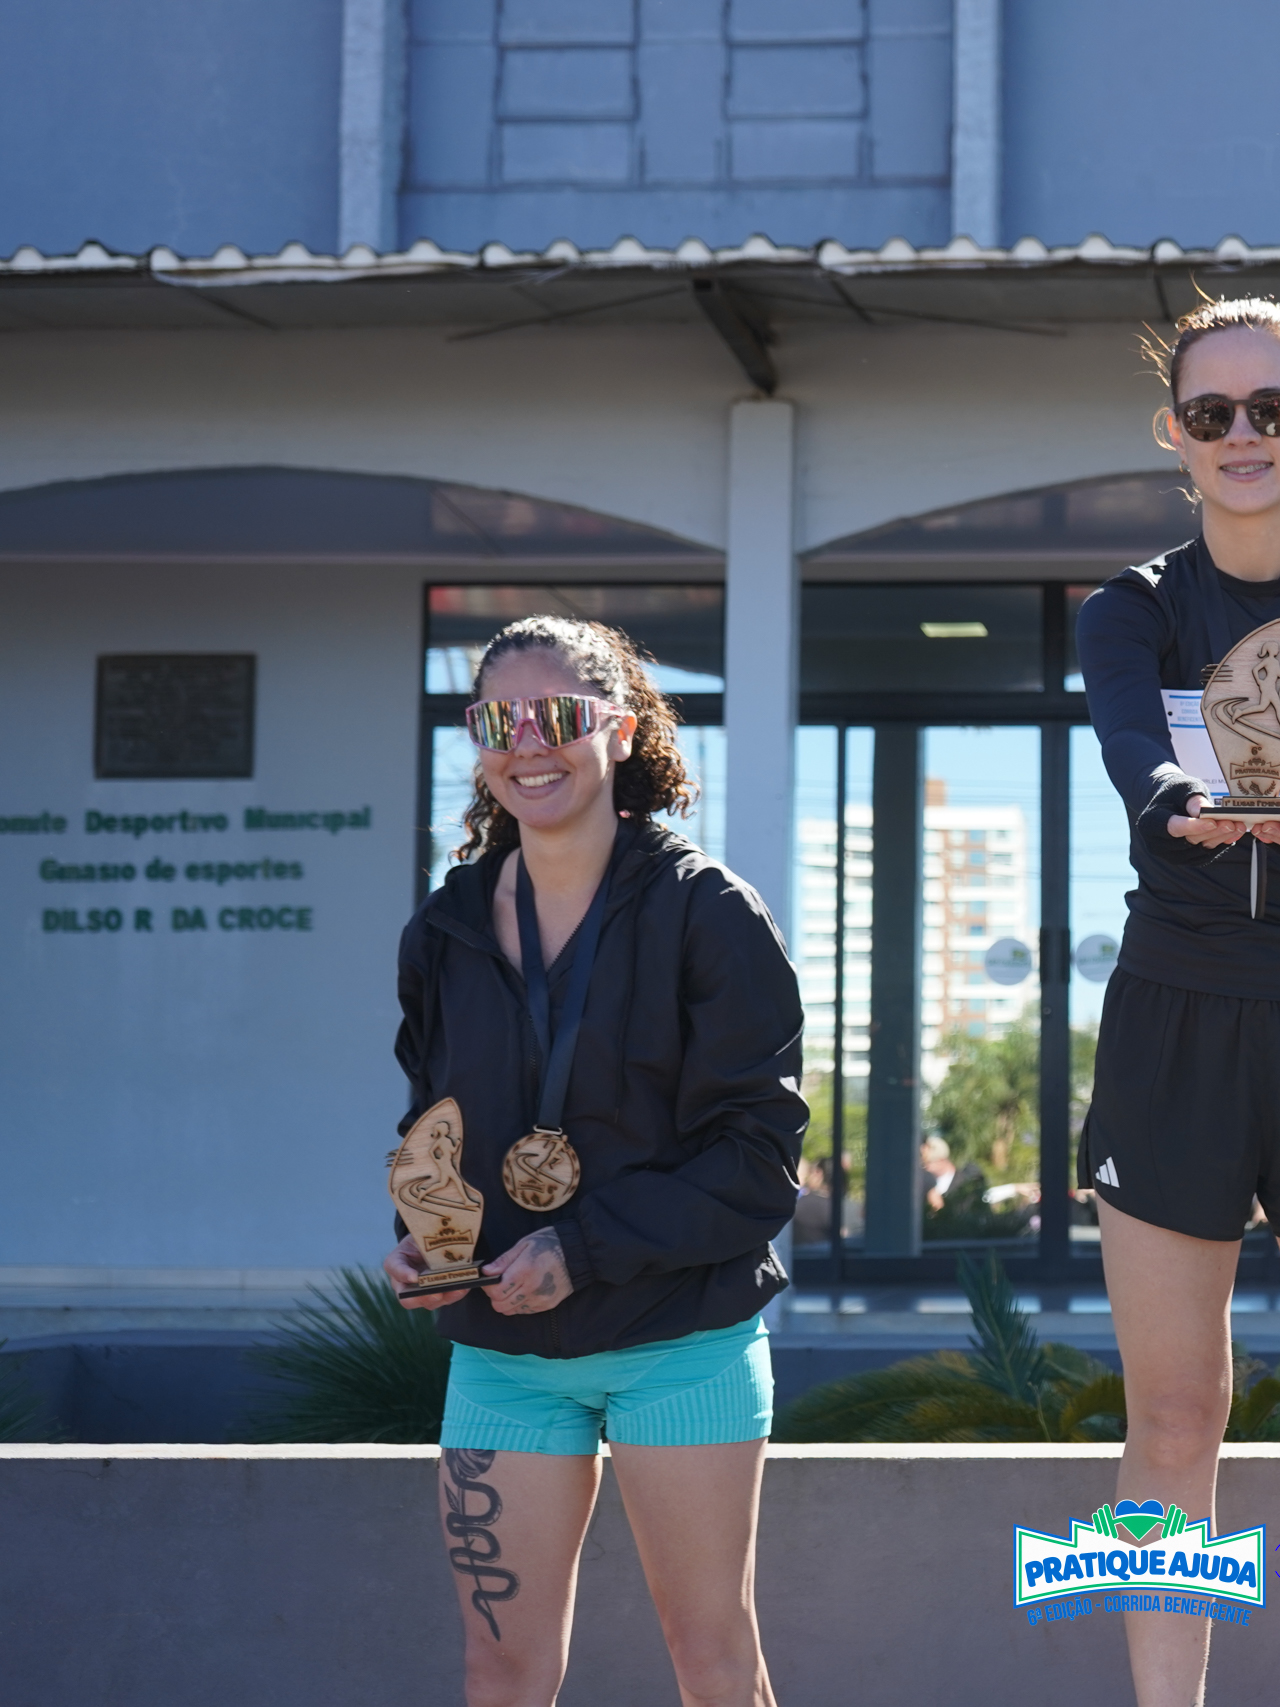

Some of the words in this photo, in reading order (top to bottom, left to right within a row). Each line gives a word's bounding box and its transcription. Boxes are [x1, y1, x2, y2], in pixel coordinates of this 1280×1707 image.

[244, 805, 371, 835] Municipal
[146, 857, 175, 882] de
[185, 858, 303, 885] esportes
[43, 907, 122, 932] DILSO
[171, 907, 207, 932] DA
[218, 906, 313, 932] CROCE
